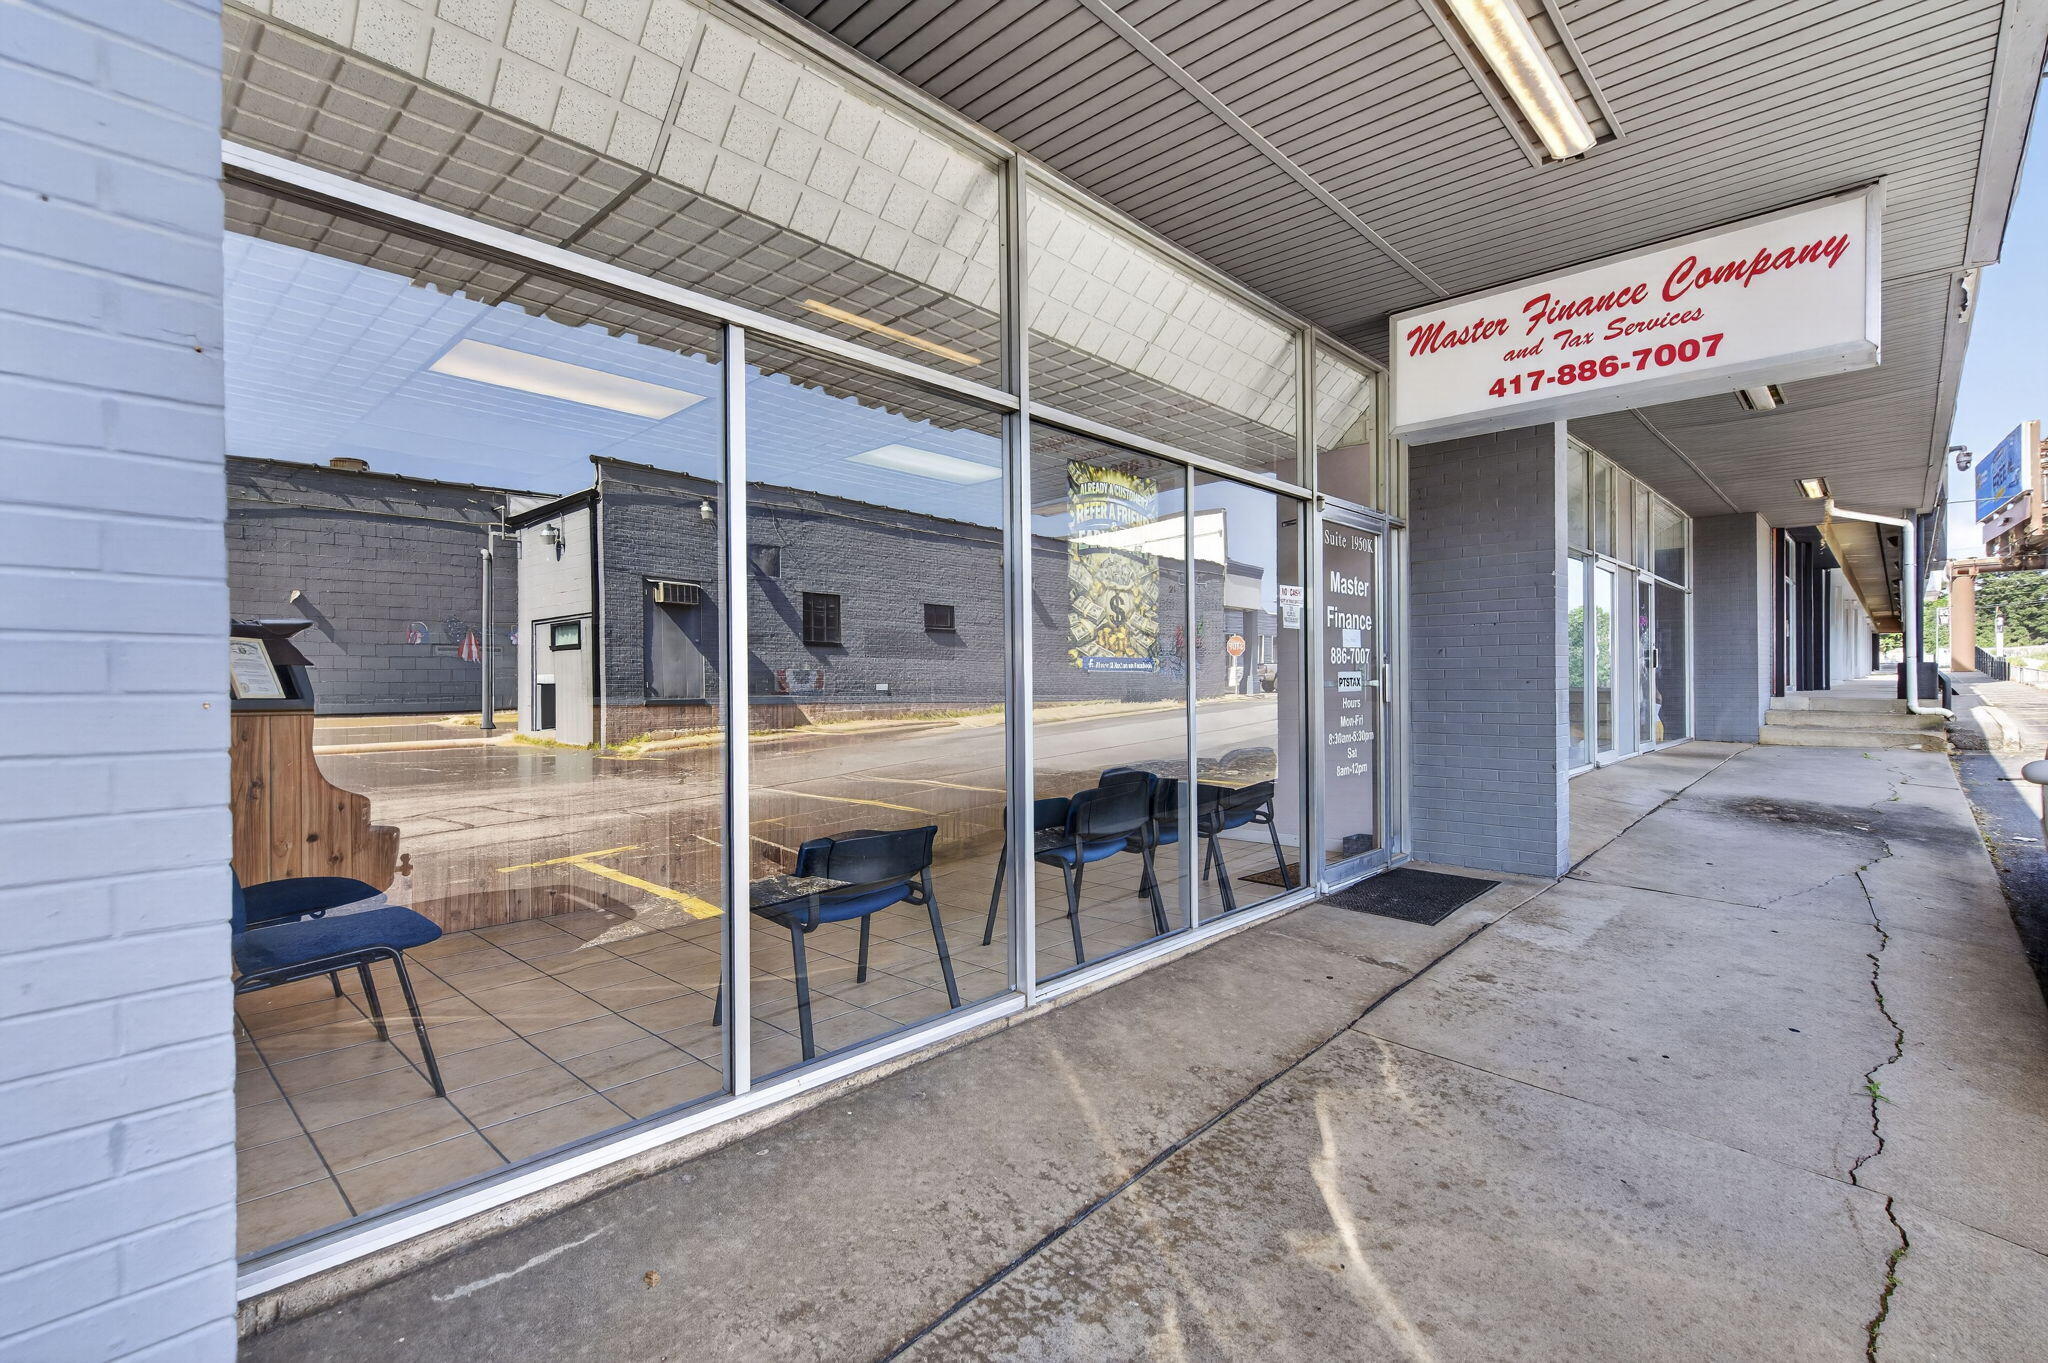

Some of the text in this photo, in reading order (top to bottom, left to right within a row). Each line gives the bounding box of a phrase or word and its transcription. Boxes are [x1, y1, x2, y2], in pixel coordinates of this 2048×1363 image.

[1407, 233, 1850, 357] Master Finance Company
[1503, 307, 1704, 362] and Tax Services
[1488, 333, 1724, 398] 417-886-7007
[1080, 482, 1108, 496] ALREADY
[1076, 501, 1108, 523] REFER
[1109, 503, 1116, 521] A
[1324, 529, 1374, 553] Suite 1950K
[1330, 571, 1369, 597] Master
[1327, 605, 1372, 631] Finance
[1330, 647, 1370, 664] 886-7007
[1339, 677, 1361, 687] PTSTAX
[1342, 697, 1361, 709] Hours
[1340, 714, 1364, 727] Mon-Fri
[1347, 747, 1358, 758] Sat
